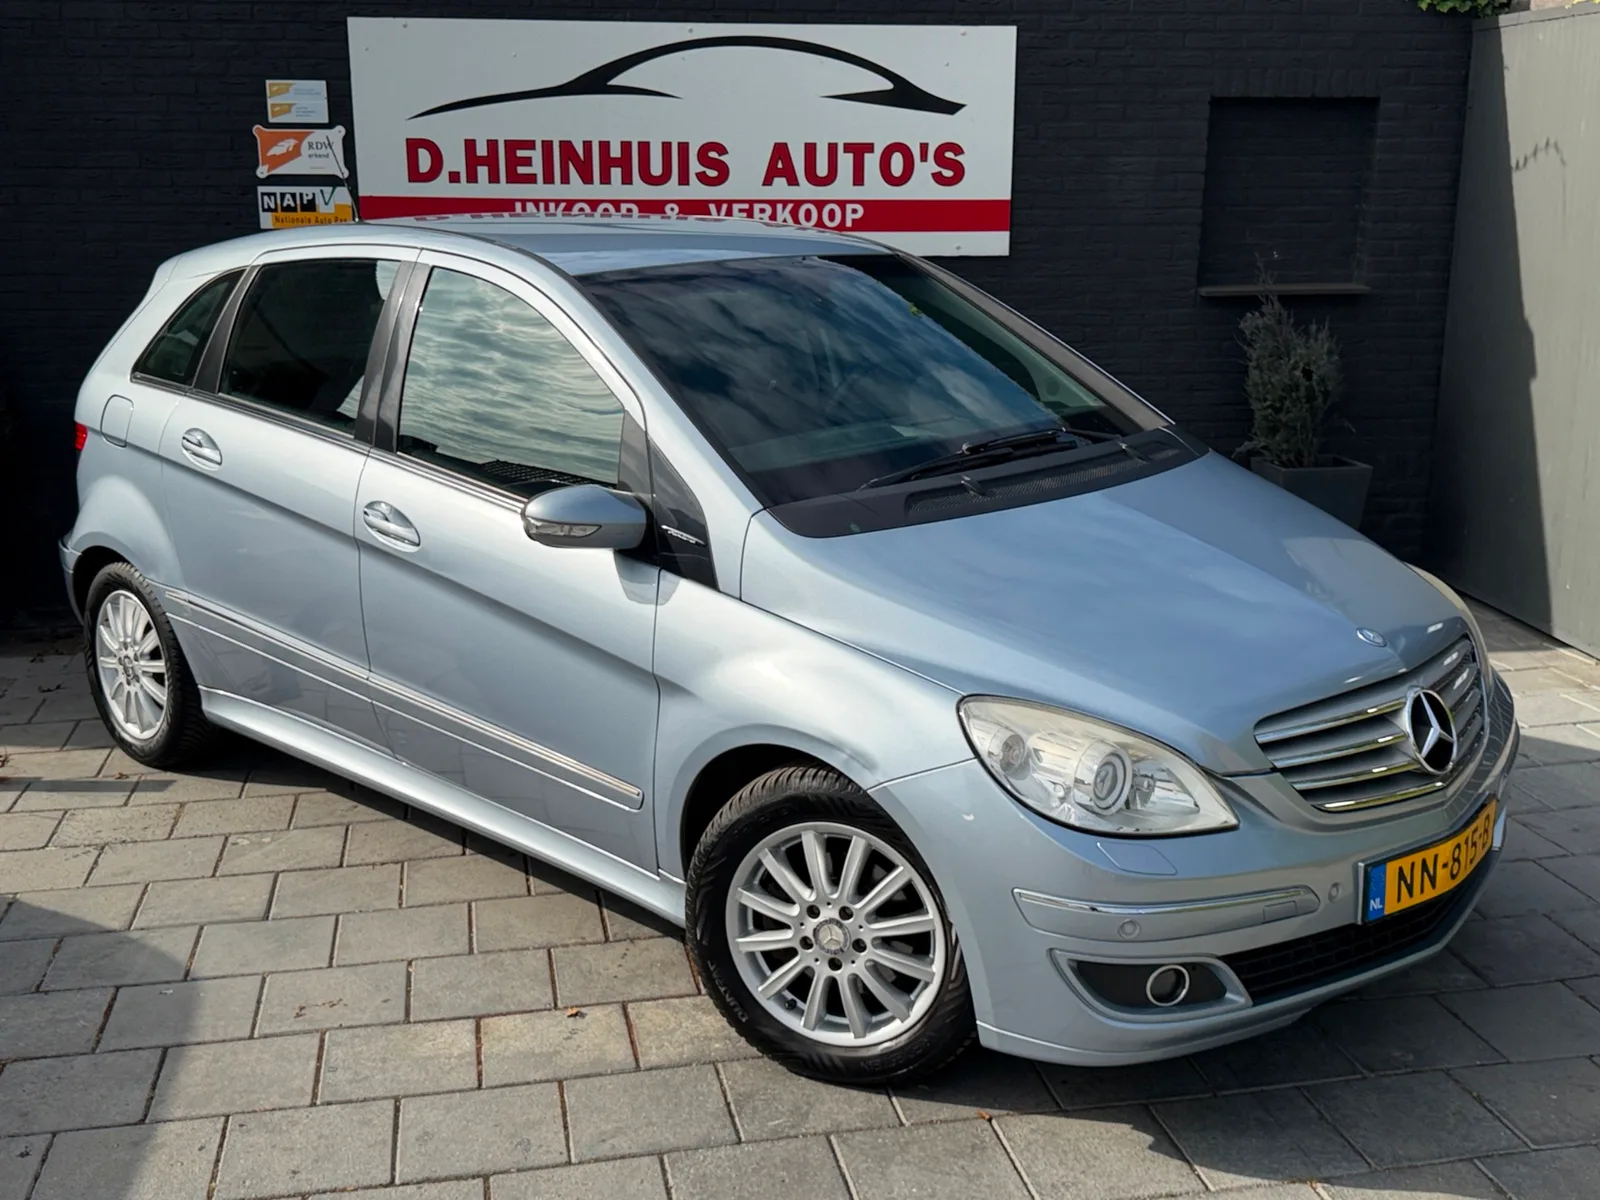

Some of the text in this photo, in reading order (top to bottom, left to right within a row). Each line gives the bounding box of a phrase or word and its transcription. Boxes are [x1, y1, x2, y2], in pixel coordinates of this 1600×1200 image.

[308, 141, 334, 151] RDW
[406, 138, 966, 187] D.HEINHUIS AUTO'S
[708, 203, 865, 228] VERKOOP
[1369, 897, 1384, 912] NL
